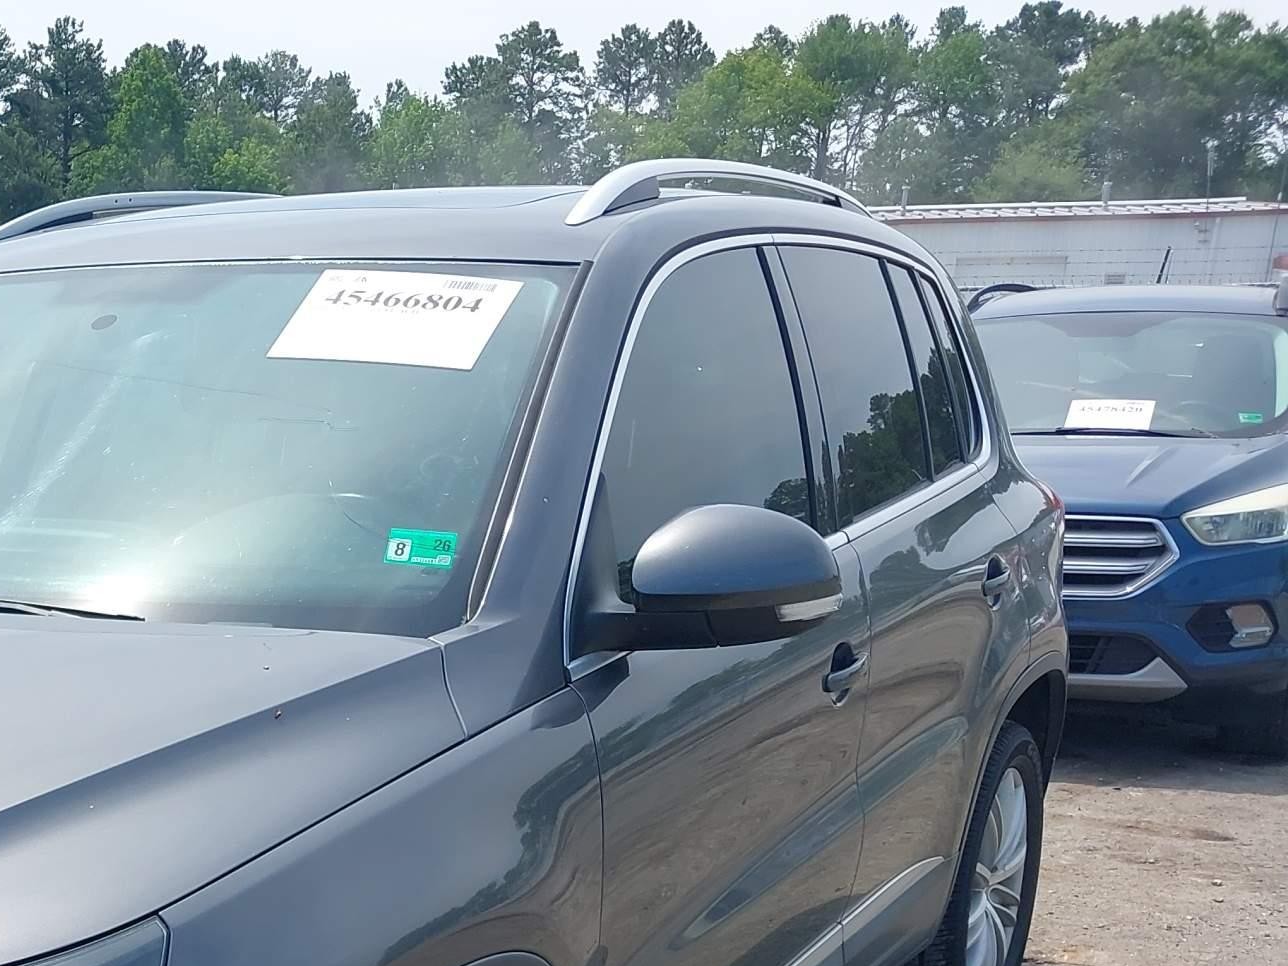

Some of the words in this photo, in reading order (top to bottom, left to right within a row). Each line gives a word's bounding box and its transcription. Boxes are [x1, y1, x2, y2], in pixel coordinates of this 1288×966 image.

[324, 288, 484, 314] 45466804
[395, 543, 406, 556] 8
[434, 539, 451, 552] 26
